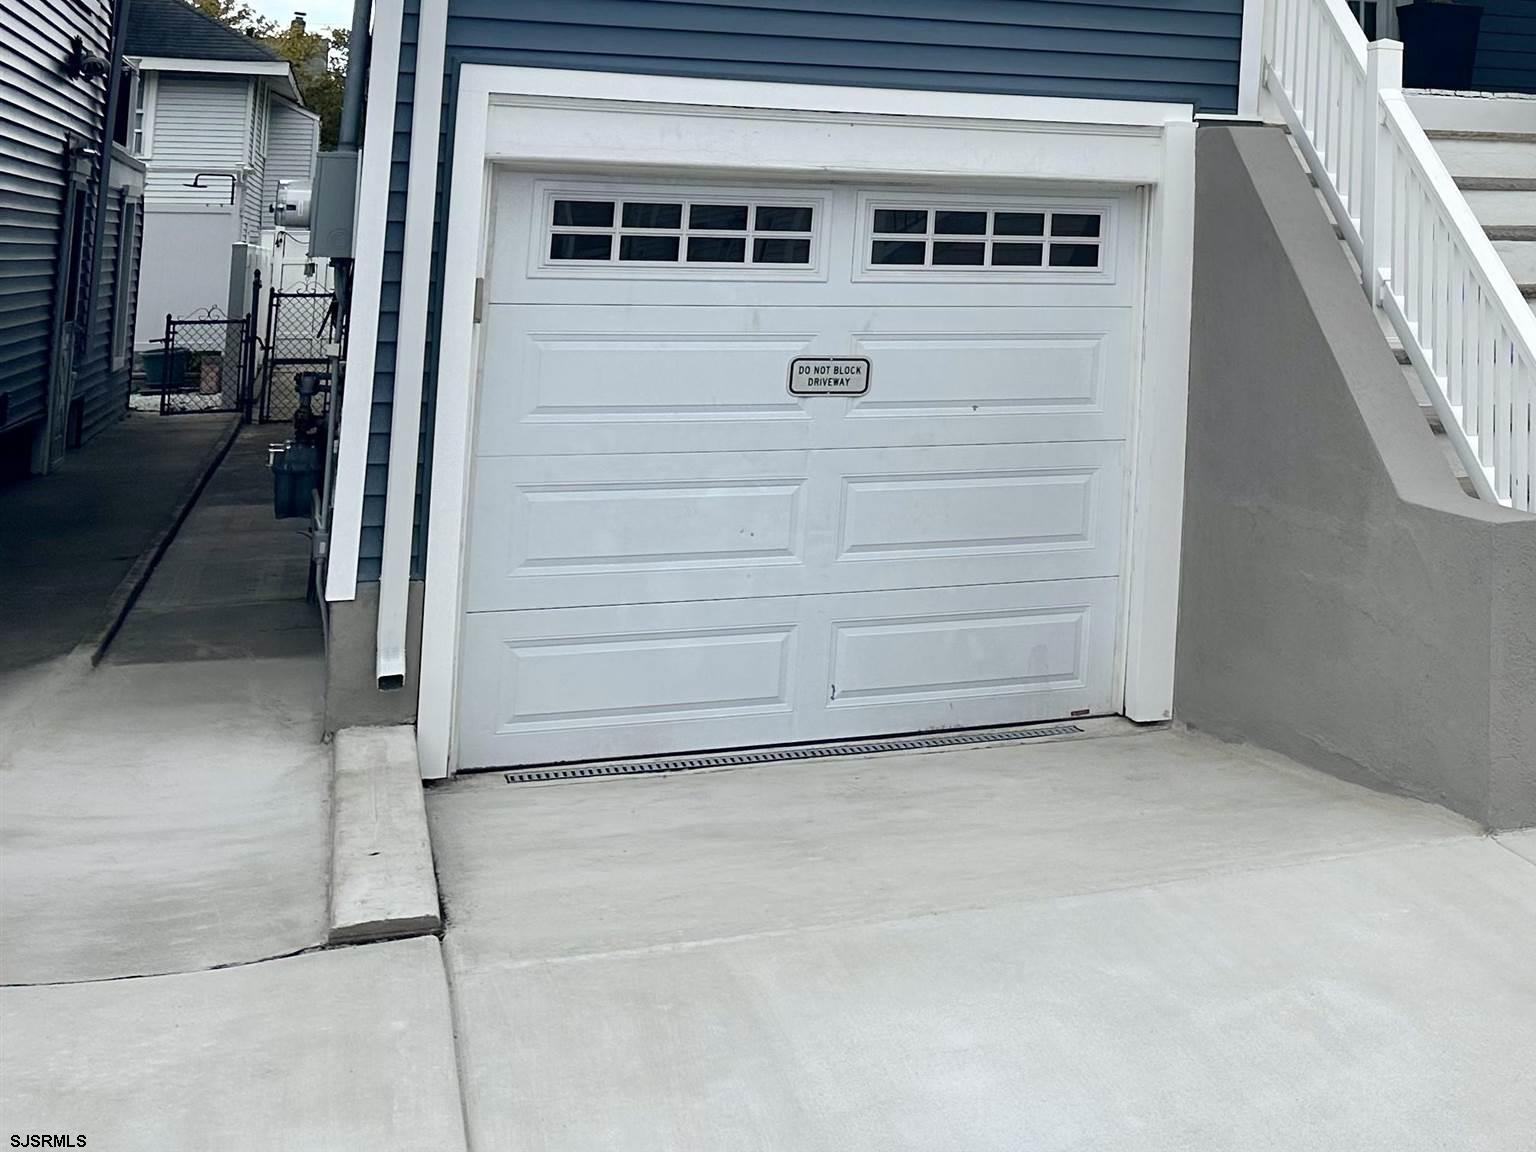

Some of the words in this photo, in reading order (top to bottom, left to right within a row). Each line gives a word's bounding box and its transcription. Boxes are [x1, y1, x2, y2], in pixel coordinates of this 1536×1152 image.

[798, 366, 811, 375] DO
[814, 366, 831, 375] NOT
[833, 366, 861, 375] BLOCK
[808, 377, 851, 387] DRIVEWAY
